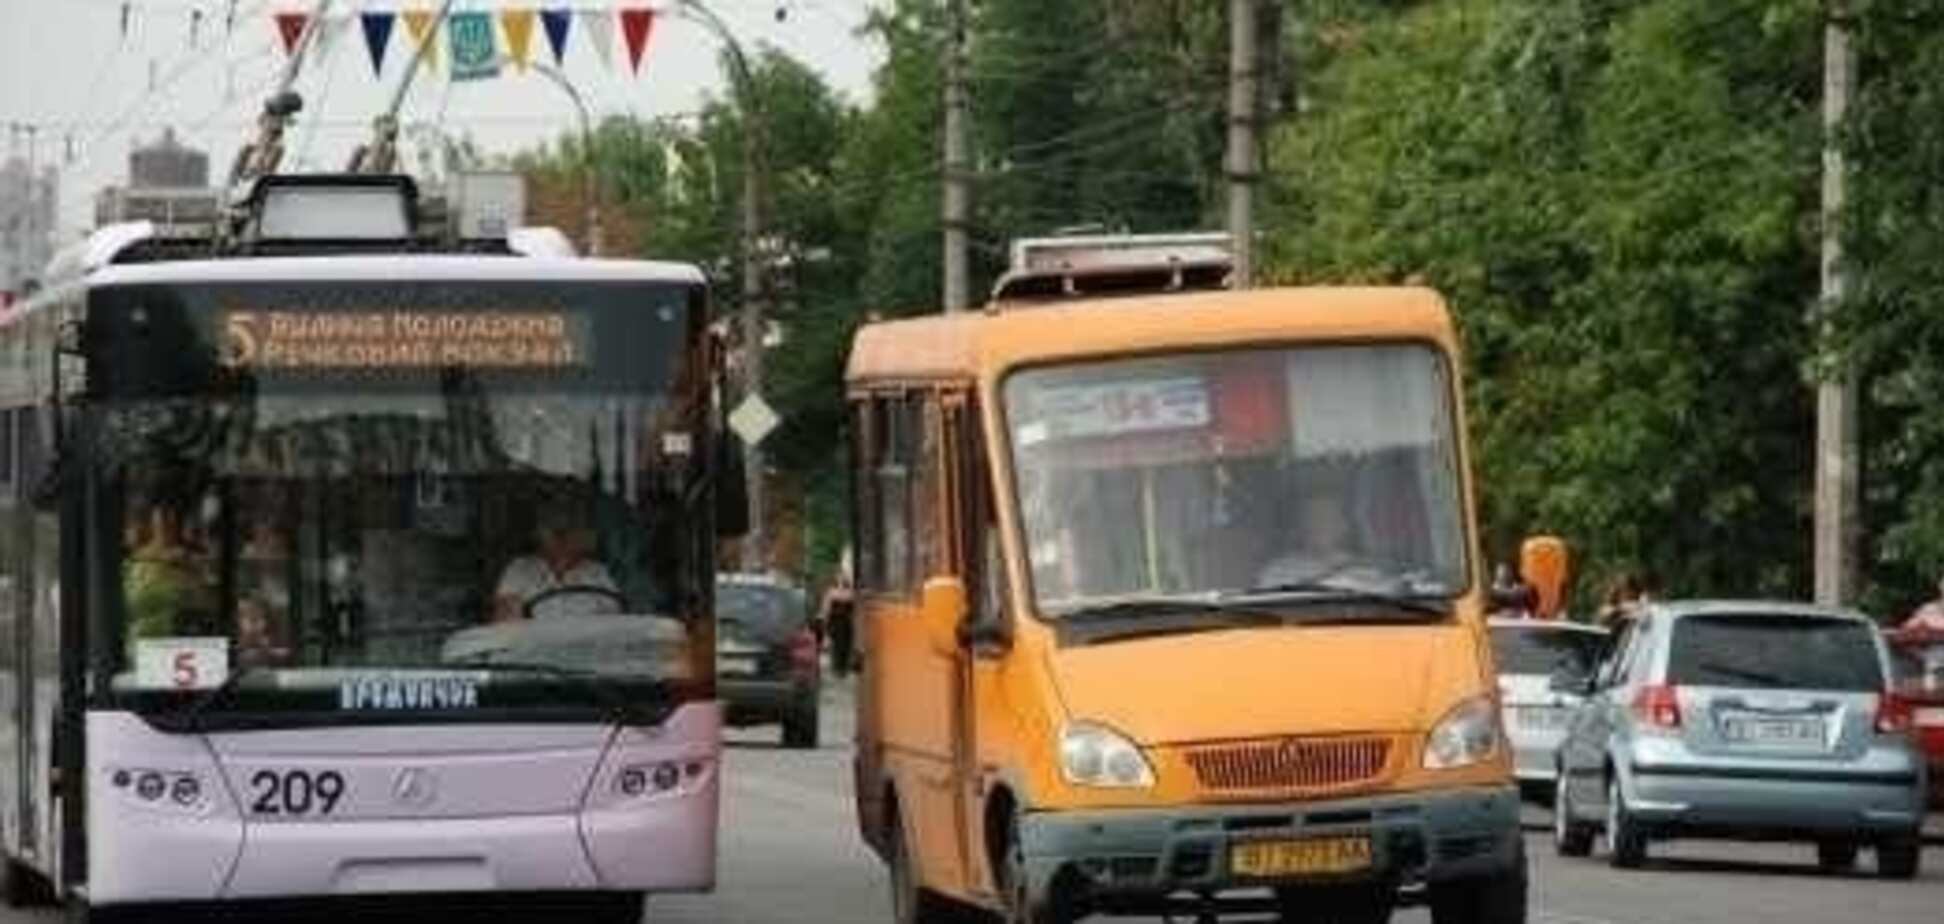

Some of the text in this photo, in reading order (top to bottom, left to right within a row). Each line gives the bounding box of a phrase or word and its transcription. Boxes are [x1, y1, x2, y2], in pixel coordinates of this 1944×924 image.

[221, 312, 256, 368] 5
[174, 651, 198, 688] 5
[251, 769, 346, 814] 209
